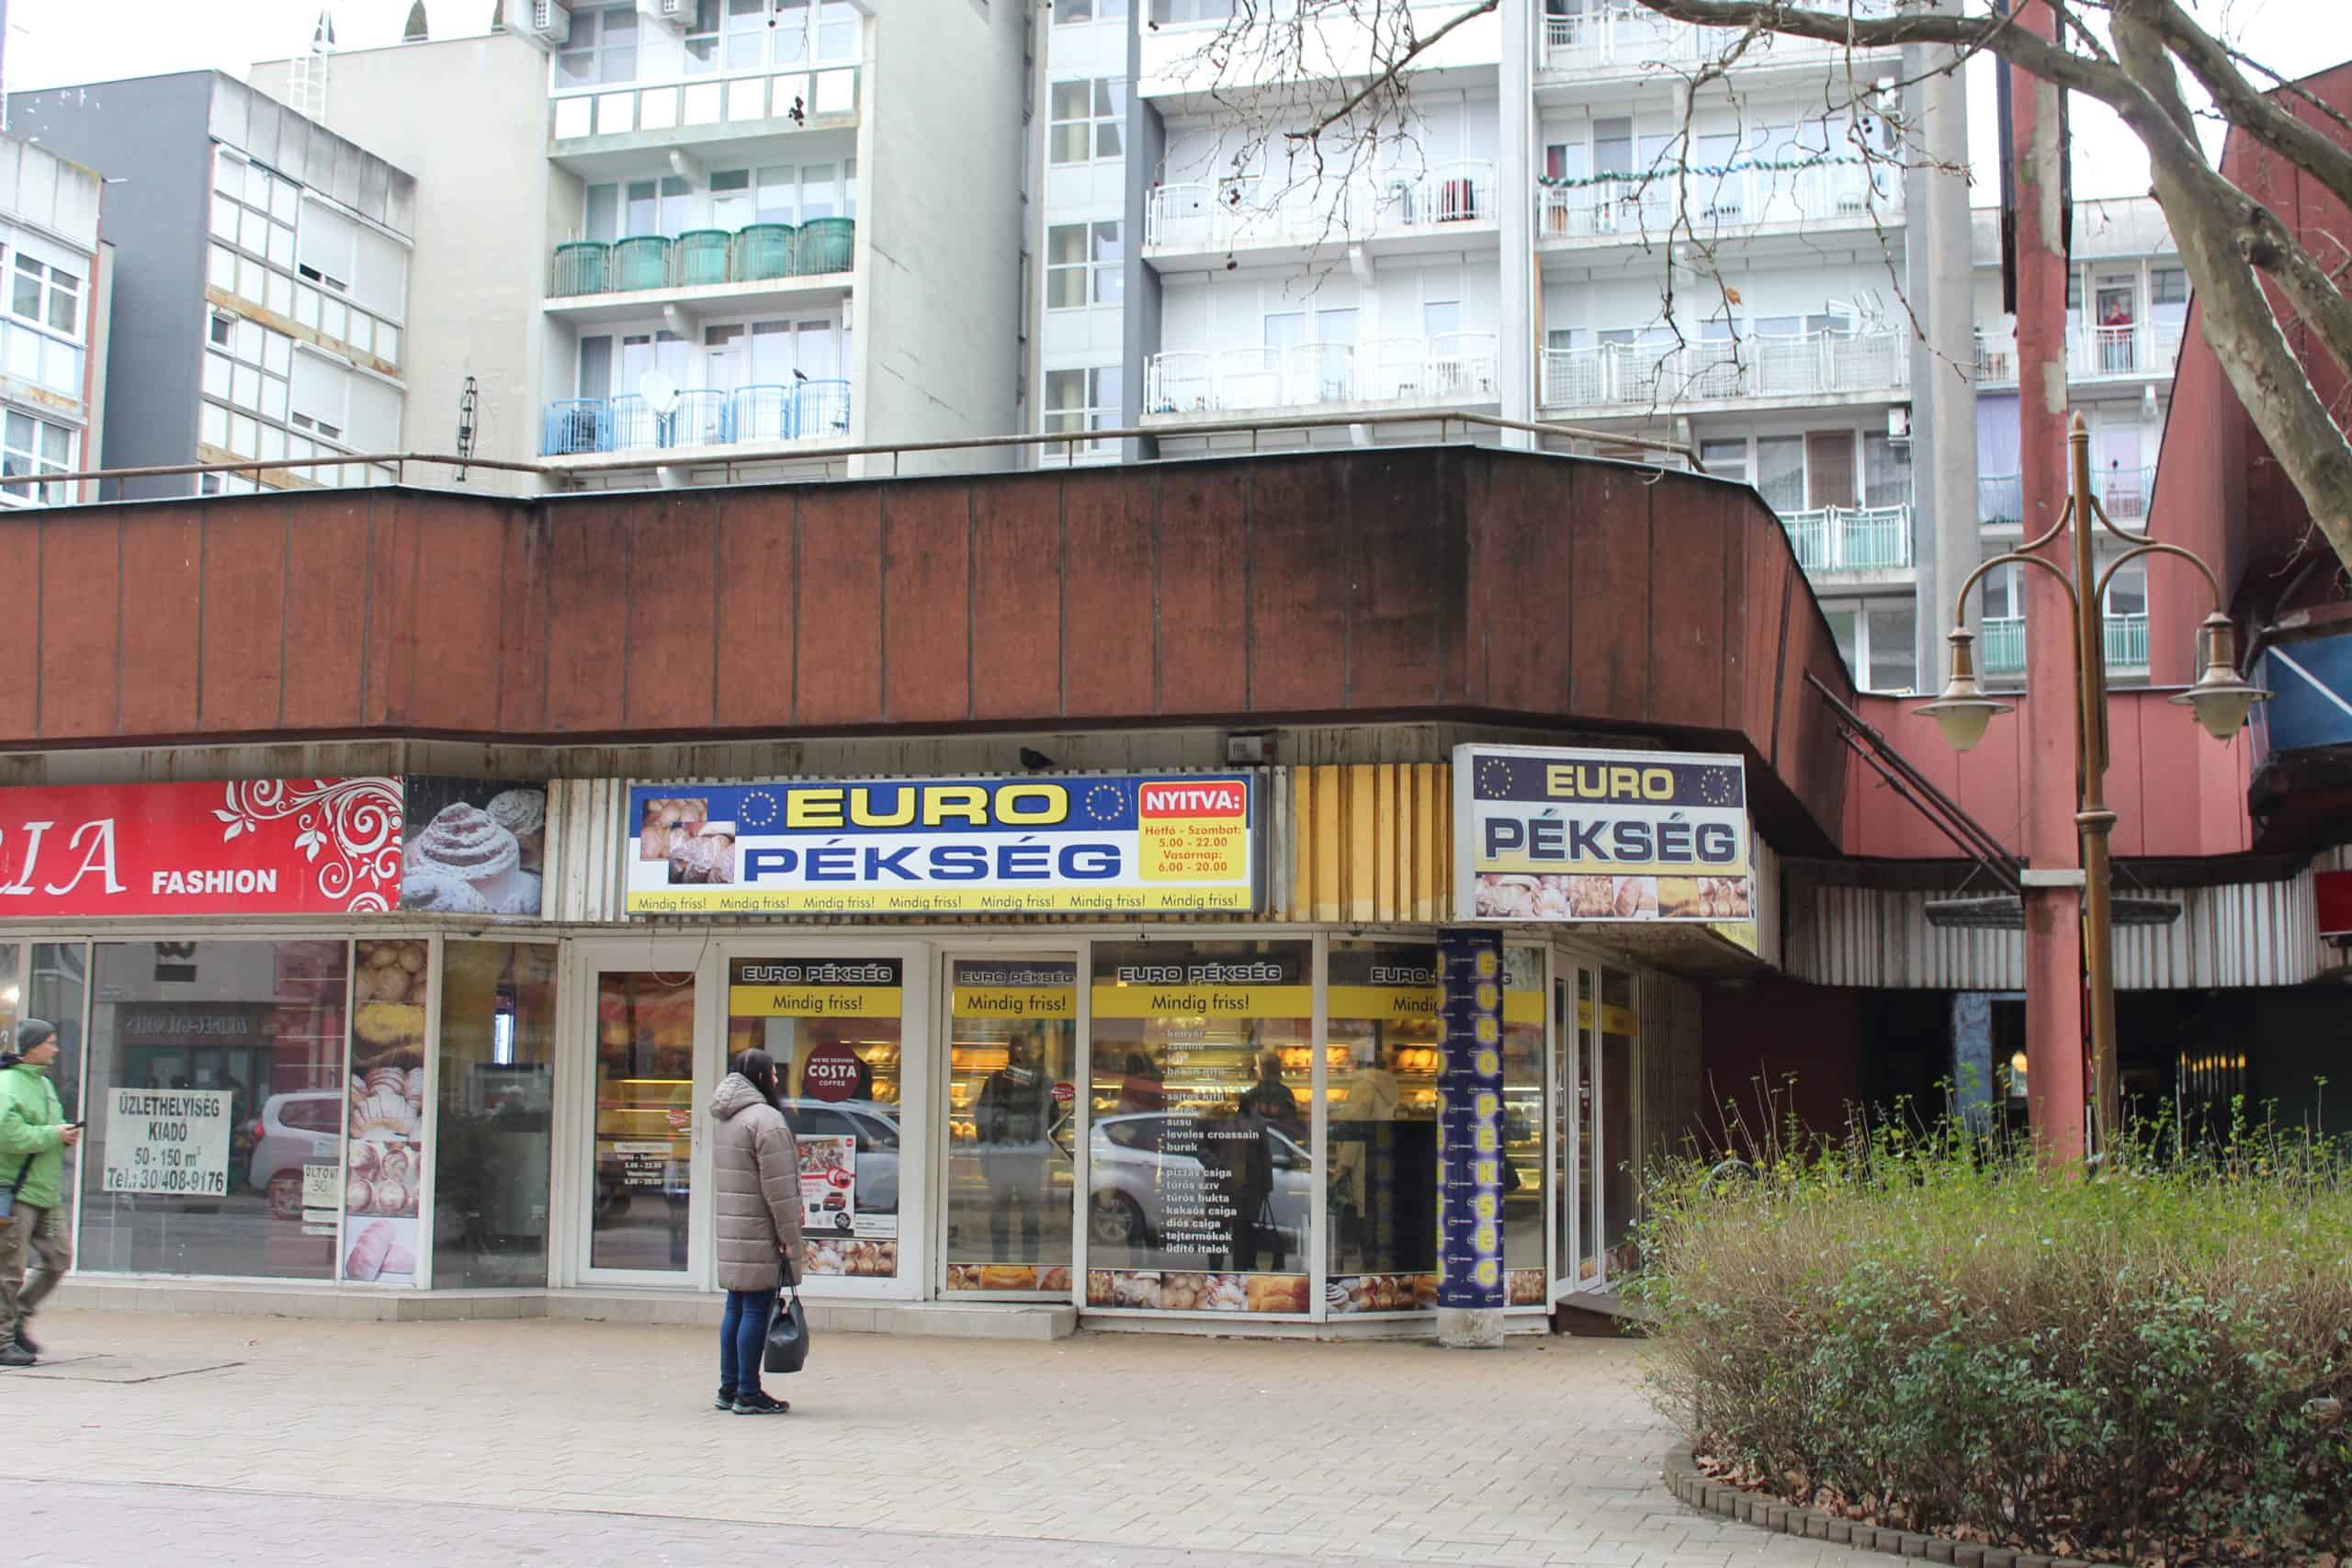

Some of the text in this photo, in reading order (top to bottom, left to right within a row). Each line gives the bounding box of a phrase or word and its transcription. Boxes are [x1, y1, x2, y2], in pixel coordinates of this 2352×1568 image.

[1545, 763, 1675, 800] EURO
[786, 784, 1069, 829] EURO
[1146, 790, 1240, 810] NYITVA:
[1159, 838, 1183, 847] 5.00
[1196, 837, 1227, 847] 22.00
[1484, 807, 1737, 863] PÉKSÉG
[0, 818, 277, 896] IA FASHION
[743, 836, 1122, 883] PÉKSÉG
[1159, 863, 1183, 872] 6.00
[1195, 862, 1227, 872] 20.00
[639, 893, 1238, 910] Mindig friss! Mindig friss! Mindig friss! Mindig friss! Mindig friss! Mindig friss! Mindig friss!
[742, 964, 893, 982] EURO PÉKSÉG
[961, 969, 1075, 984] EURO PÉKSÉG
[1117, 962, 1283, 982] EURO PÉKSÉG
[1370, 966, 1426, 984] EURO
[773, 994, 863, 1012] Mindig friss!
[967, 994, 1066, 1014] Mindig friss!
[1151, 993, 1250, 1013] Mindig friss!
[808, 1065, 856, 1078] COSTA
[148, 1118, 187, 1142] KIADÓ
[1167, 1130, 1204, 1139] leveles
[134, 1147, 150, 1165] 50
[161, 1148, 181, 1167] 150
[107, 1168, 137, 1189] Tel.:
[1204, 1168, 1232, 1179] csiga
[1198, 1193, 1229, 1202] bukta
[1207, 1206, 1238, 1217] csiga
[1192, 1219, 1221, 1229] csiga
[1166, 1231, 1232, 1242] tejtermékek
[1197, 1245, 1229, 1254] italok
